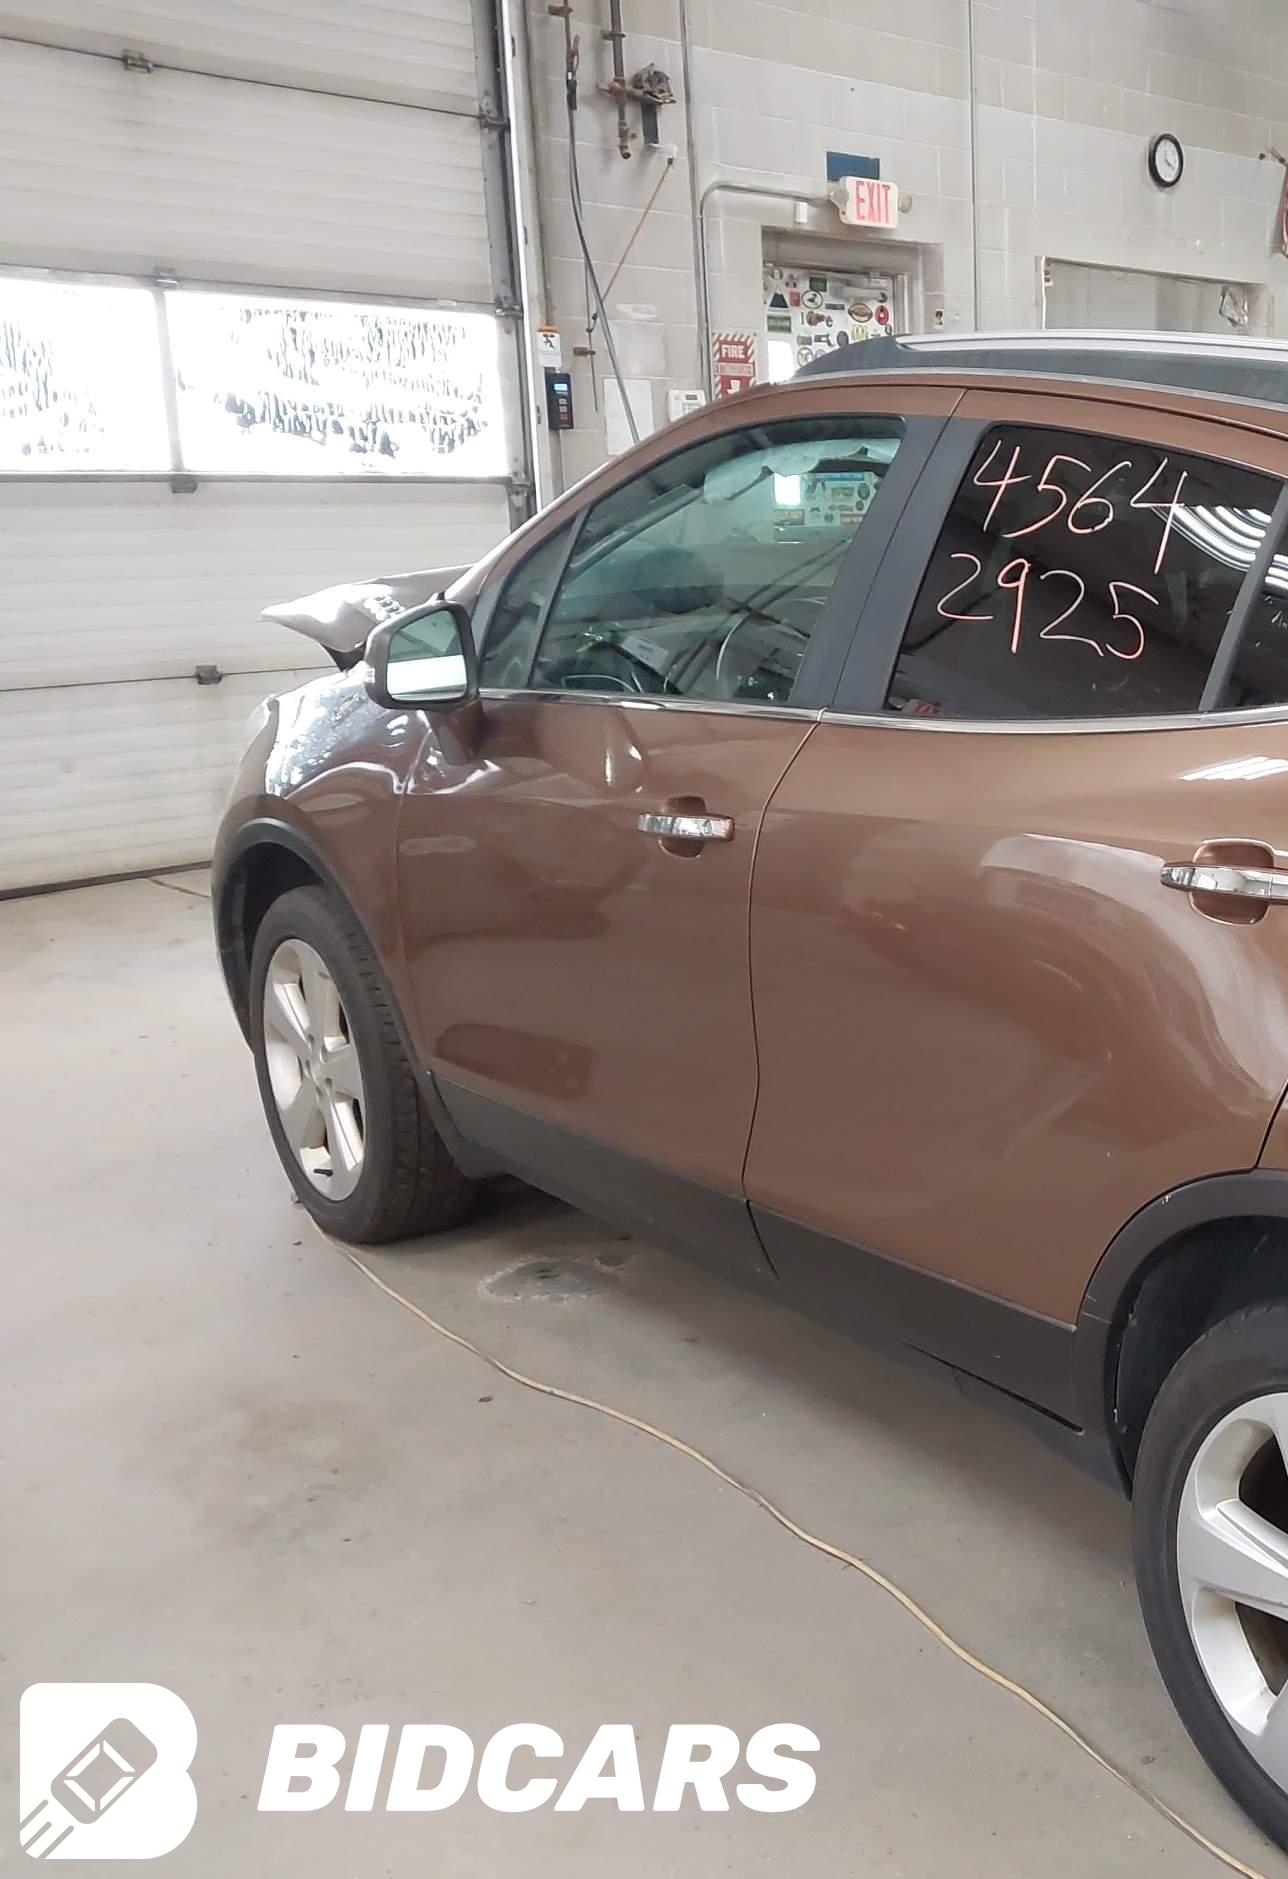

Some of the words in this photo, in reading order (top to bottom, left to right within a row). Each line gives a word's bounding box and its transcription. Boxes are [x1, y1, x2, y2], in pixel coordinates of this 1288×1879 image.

[856, 181, 890, 223] EXIT
[721, 344, 746, 359] FIRE
[973, 439, 1188, 575] 4564
[936, 553, 1160, 660] 2925
